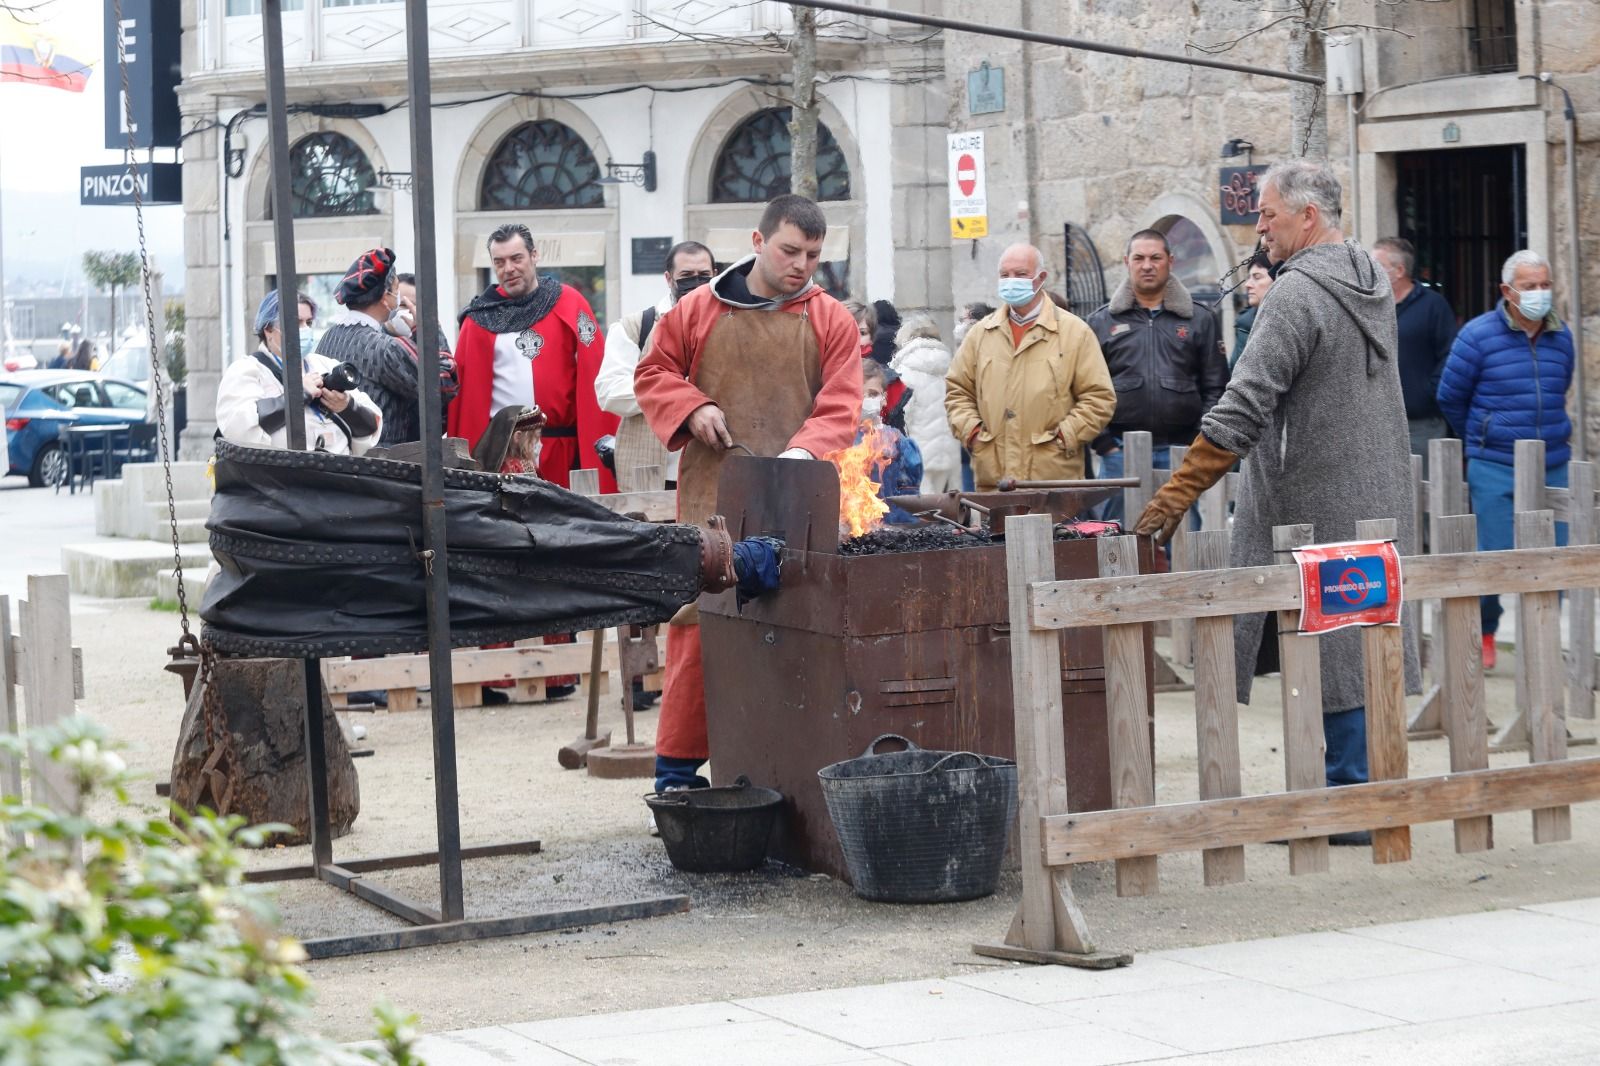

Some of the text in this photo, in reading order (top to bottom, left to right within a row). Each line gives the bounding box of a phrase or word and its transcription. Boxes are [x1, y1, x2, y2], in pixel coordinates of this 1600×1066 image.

[84, 168, 149, 197] PINZÓN
[1324, 580, 1381, 593] PROHIBIDO EL PASO
